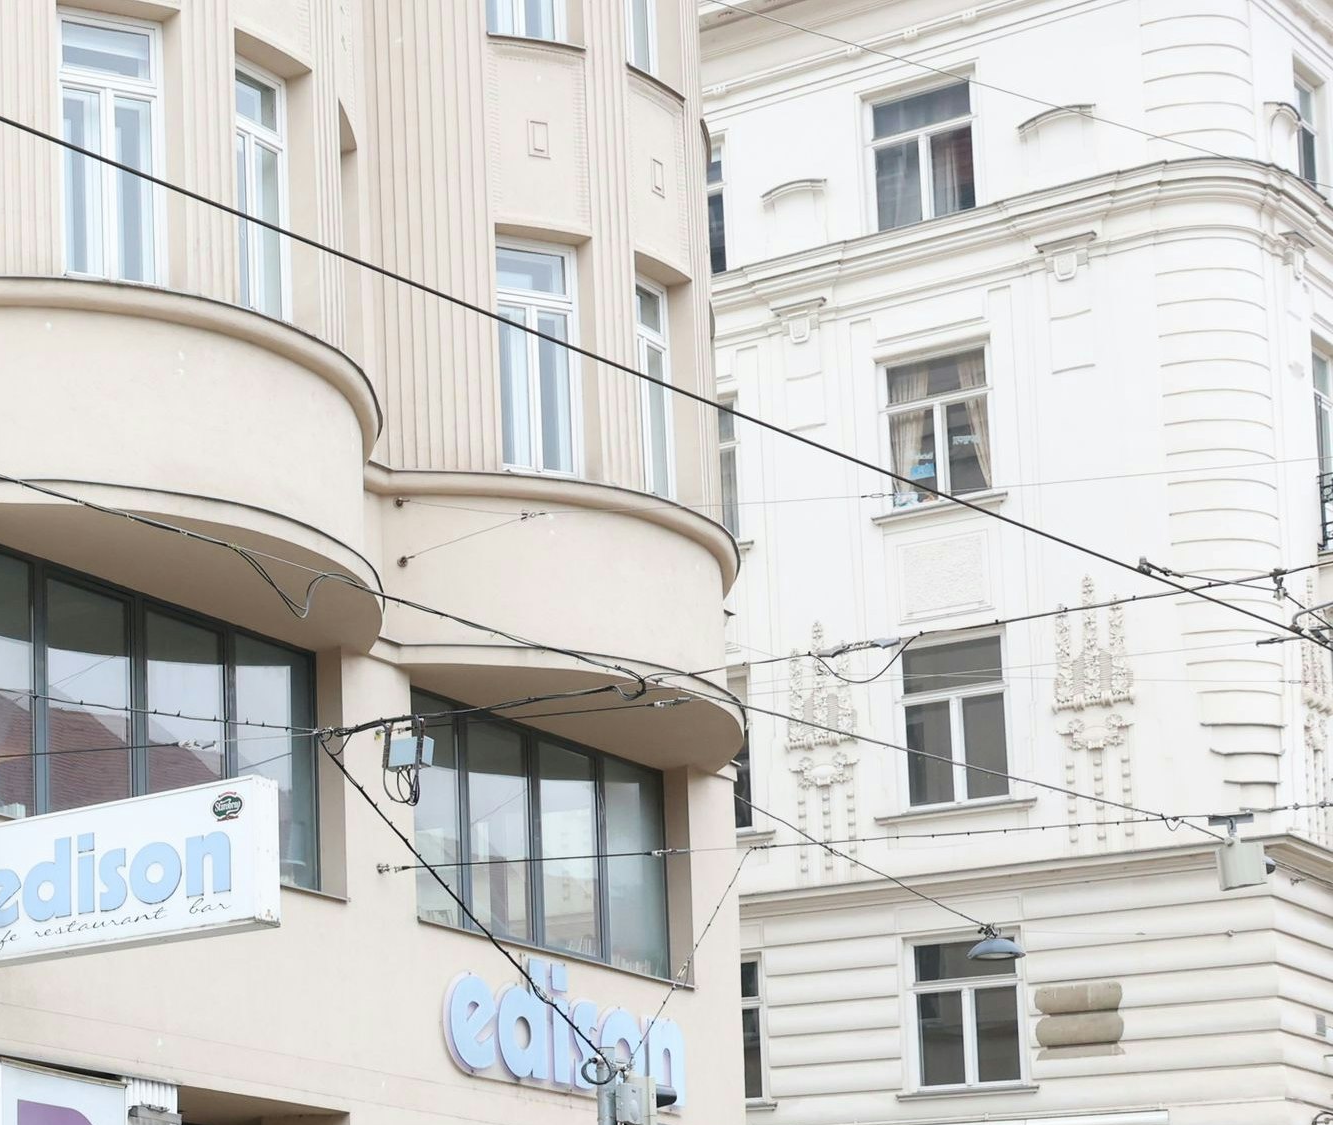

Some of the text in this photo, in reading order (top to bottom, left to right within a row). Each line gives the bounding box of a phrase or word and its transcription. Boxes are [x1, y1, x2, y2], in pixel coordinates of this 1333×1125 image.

[32, 906, 169, 938] restaurant
[187, 898, 232, 915] bar
[445, 957, 686, 1109] edison
